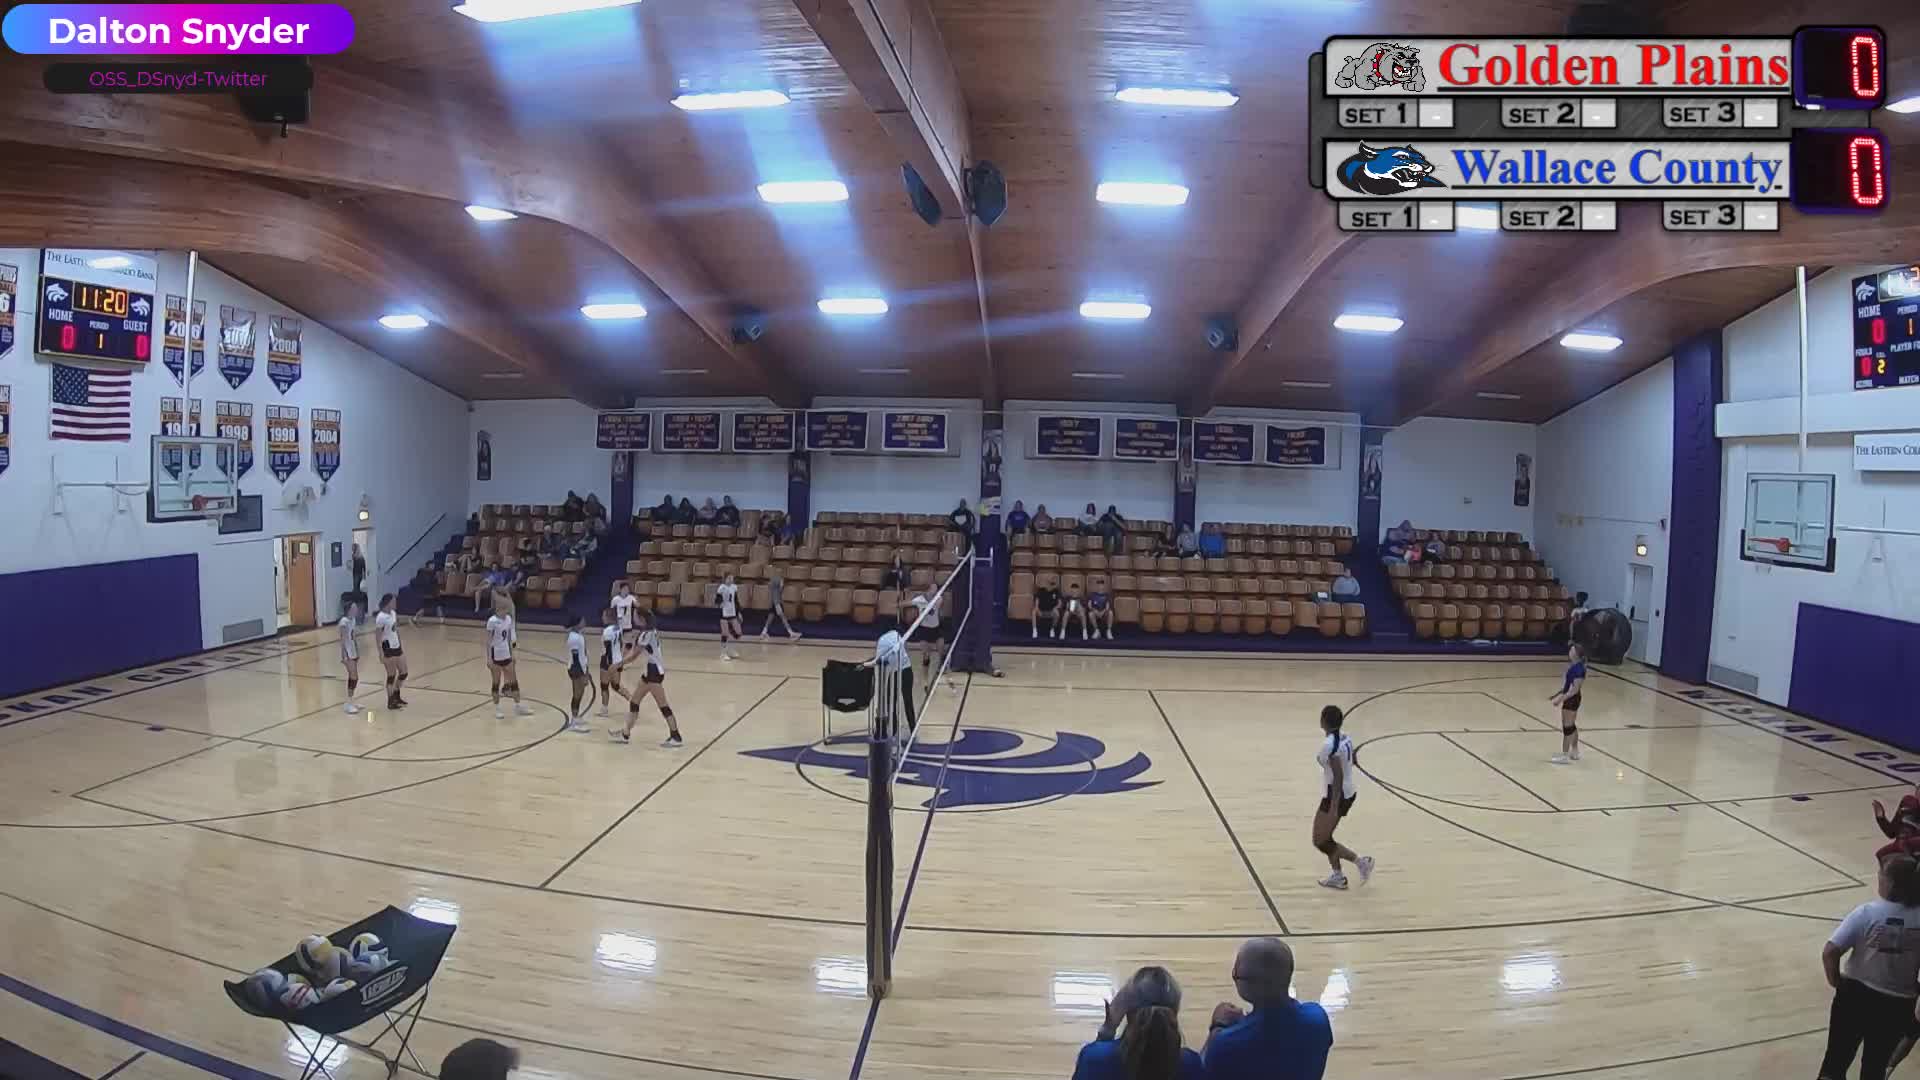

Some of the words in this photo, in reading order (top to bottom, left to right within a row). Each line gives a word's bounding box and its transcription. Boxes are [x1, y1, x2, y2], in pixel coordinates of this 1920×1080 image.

[82, 287, 126, 314] 11:20
[48, 308, 74, 322] HOME
[1858, 305, 1880, 318] HOME
[123, 319, 148, 333] GUEST
[169, 320, 201, 340] 206
[1872, 319, 1886, 344] 0
[62, 324, 75, 350] 0
[135, 334, 149, 358] 0
[166, 422, 197, 436] 197
[1856, 445, 1869, 455] THE
